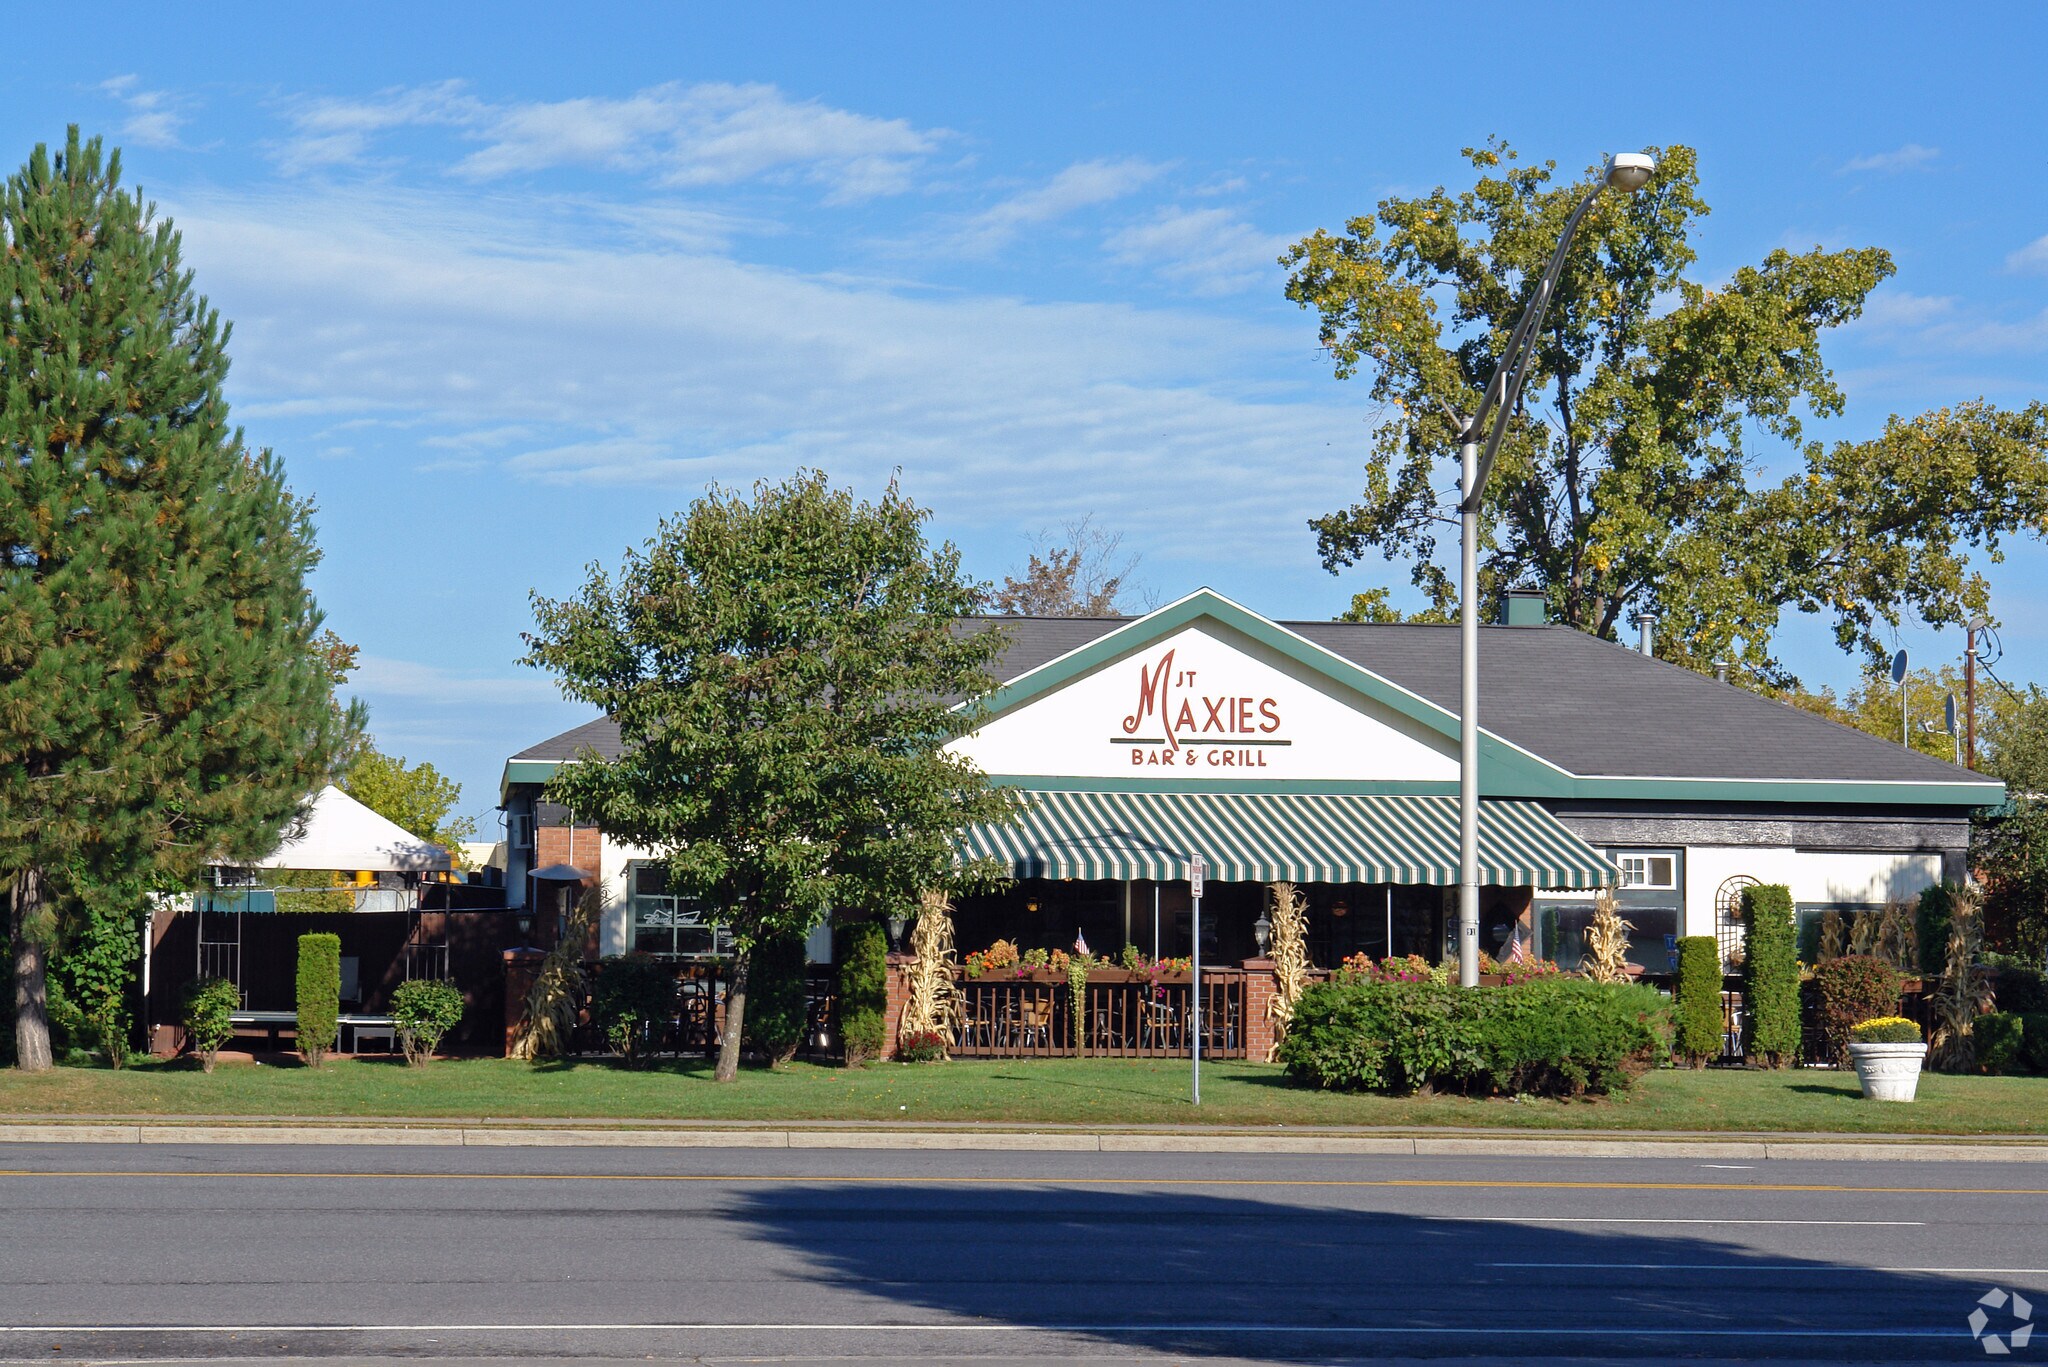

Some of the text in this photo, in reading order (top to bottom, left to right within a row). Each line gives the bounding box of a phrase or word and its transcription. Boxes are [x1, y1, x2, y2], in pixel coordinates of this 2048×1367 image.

[1176, 671, 1197, 687] JT
[1122, 648, 1281, 751] MAXIES
[1131, 749, 1267, 767] BAR & GRILL
